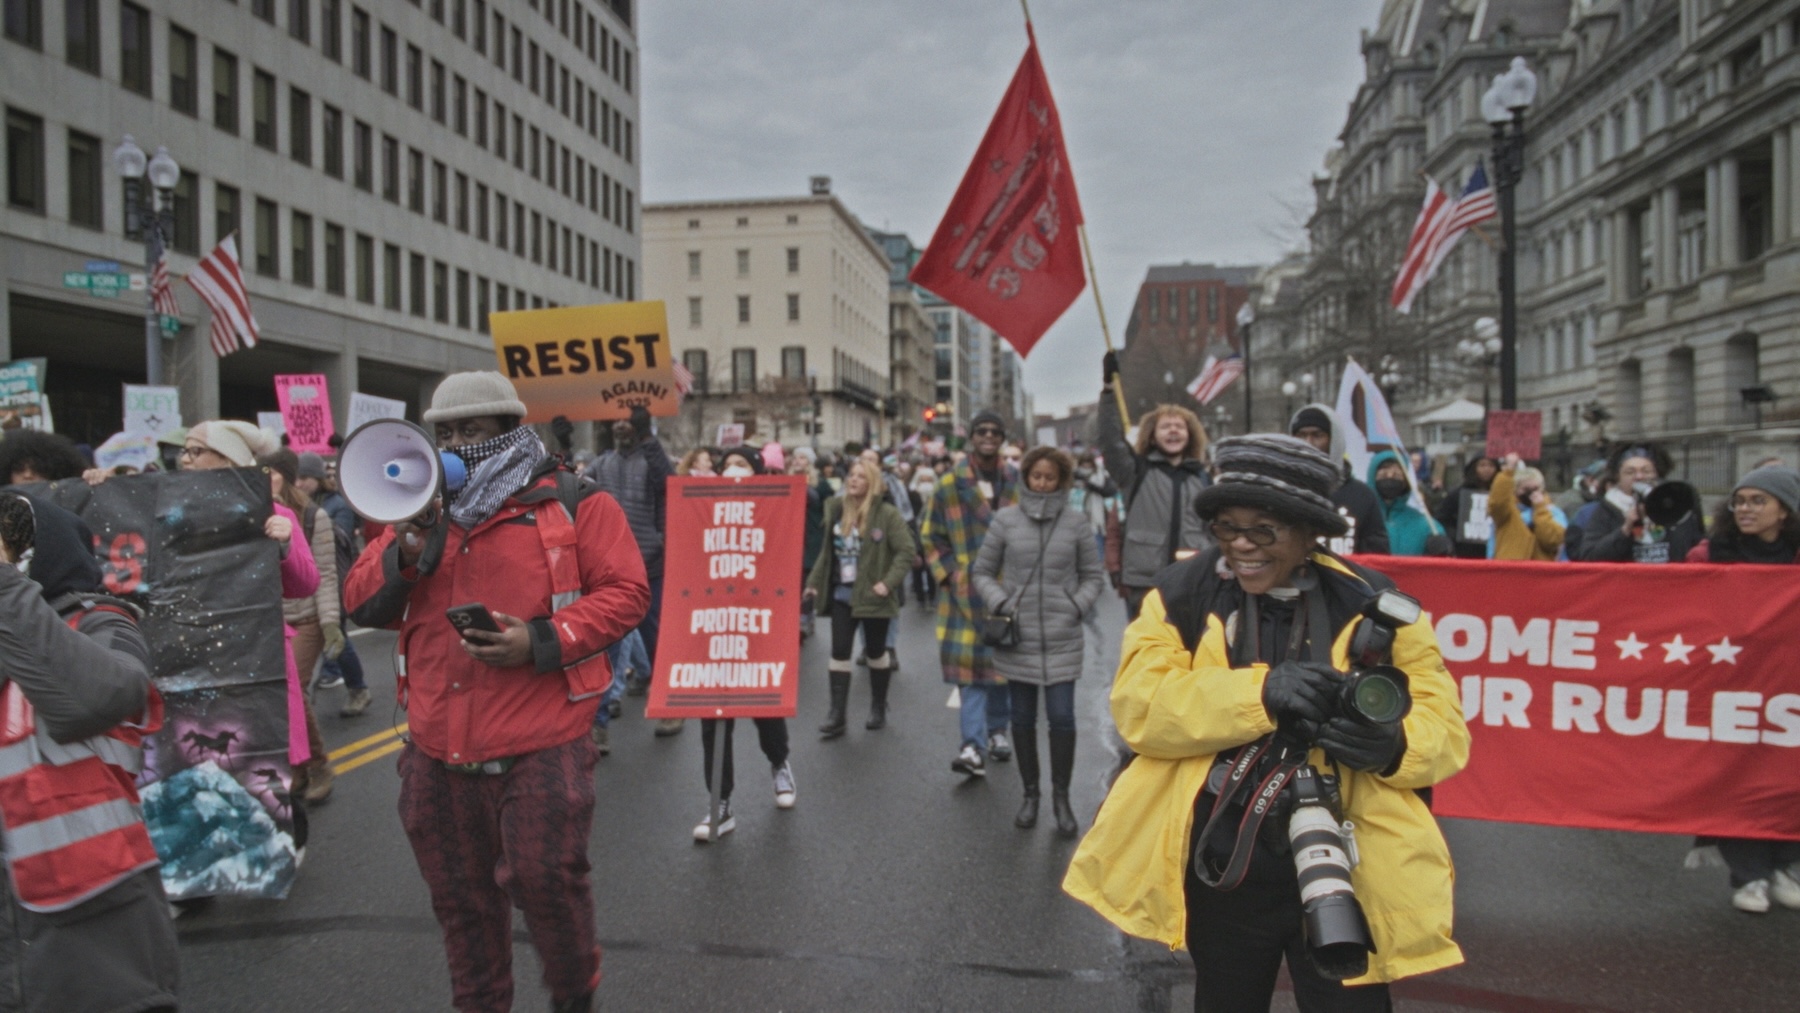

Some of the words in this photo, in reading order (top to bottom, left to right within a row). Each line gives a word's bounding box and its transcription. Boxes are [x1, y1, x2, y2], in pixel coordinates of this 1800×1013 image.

[65, 274, 88, 287] NEW
[92, 274, 118, 287] YORK
[503, 333, 660, 378] RESIST
[294, 377, 304, 385] IS
[601, 380, 668, 402] AGAIN!
[128, 392, 177, 412] DEFY
[290, 404, 322, 412] FELON
[617, 398, 652, 409] 2025
[288, 412, 324, 420] RACIST
[298, 436, 321, 445] LIAR
[713, 501, 755, 526] FIRE
[703, 527, 765, 553] KILLER
[709, 553, 756, 580] COPS
[690, 606, 772, 634] PROTECT
[708, 634, 749, 661] OUR
[669, 661, 786, 689] COMMUNITY
[1552, 681, 1800, 748] RULES
[1232, 745, 1259, 781] Canon
[1262, 772, 1286, 797] EOS
[1254, 798, 1267, 814] 6D
